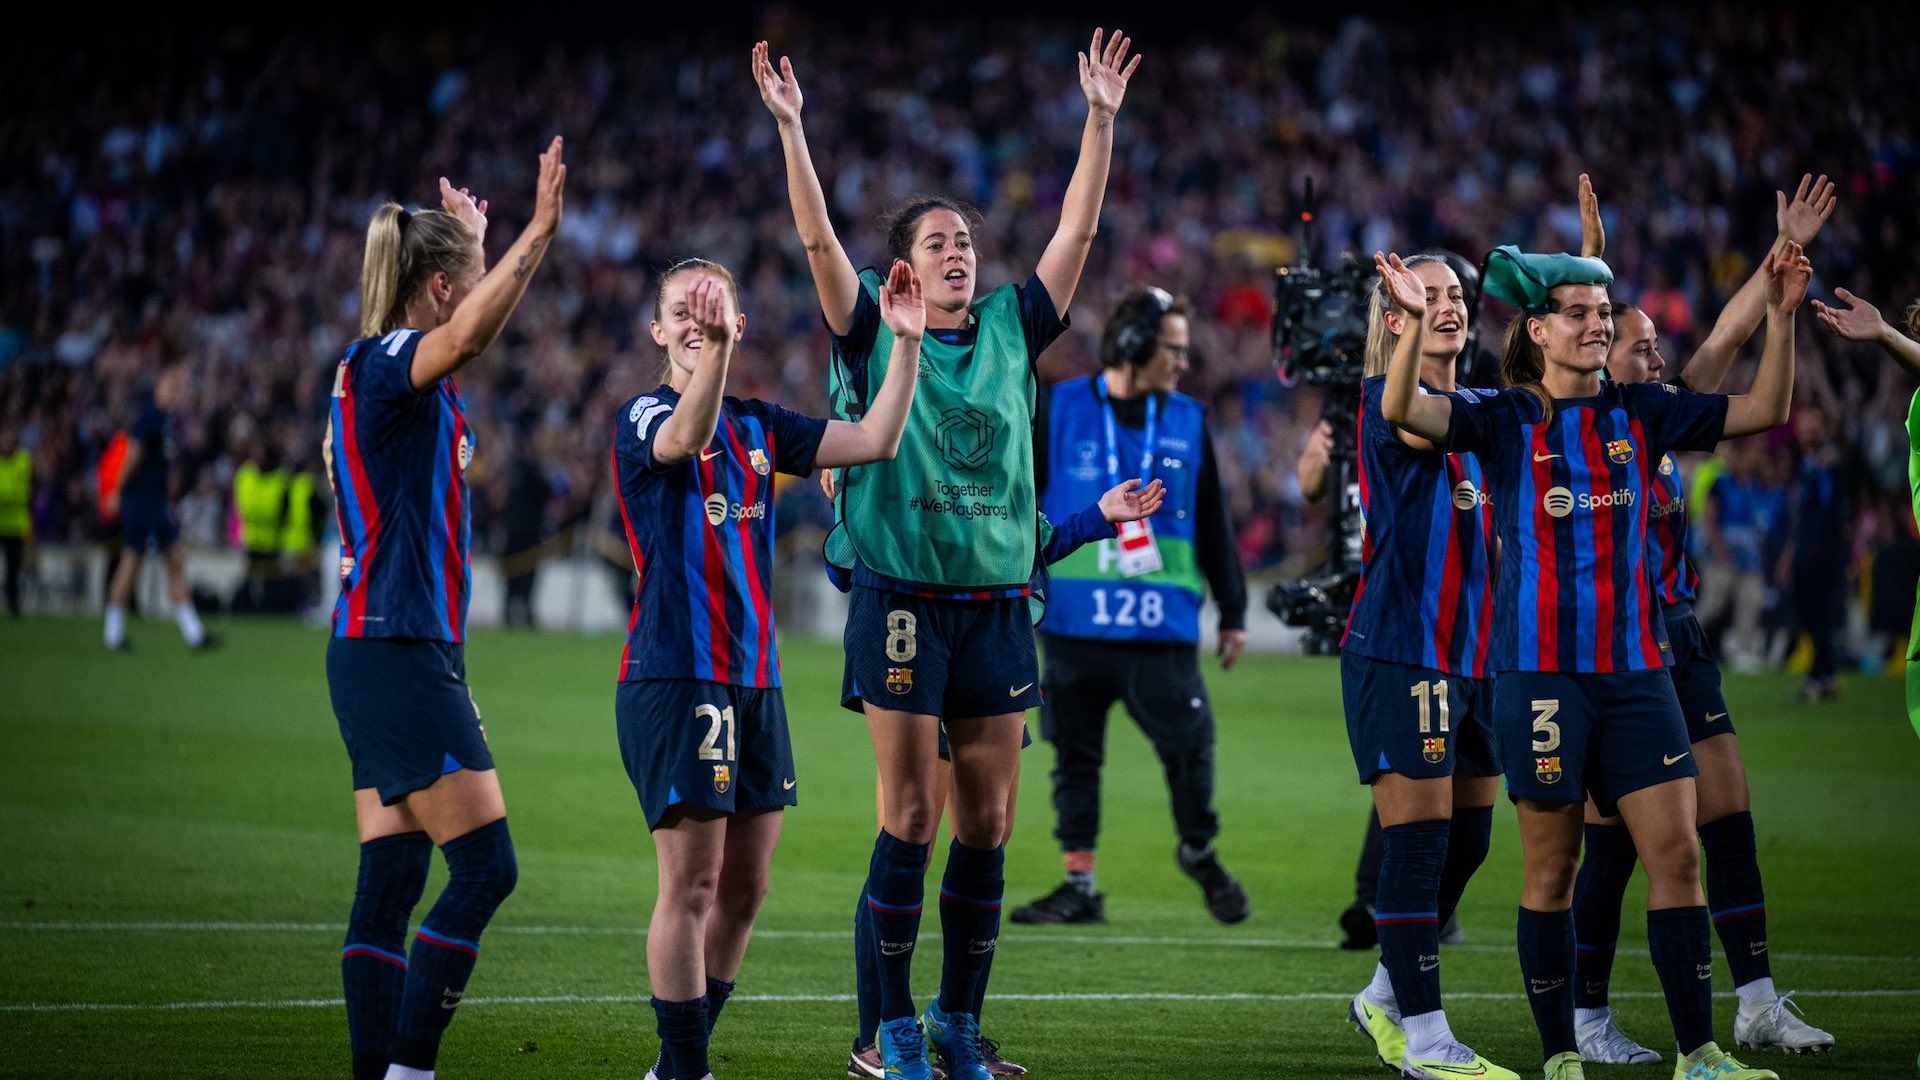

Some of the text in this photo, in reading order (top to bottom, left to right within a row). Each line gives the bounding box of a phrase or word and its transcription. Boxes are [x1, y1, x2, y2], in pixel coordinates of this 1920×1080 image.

[935, 479, 994, 500] Together
[1578, 488, 1636, 510] Spotify
[1092, 588, 1164, 627] 128
[886, 609, 917, 663] 8
[694, 703, 736, 761] 21
[1410, 679, 1450, 733] 11
[1531, 699, 1561, 752] 3
